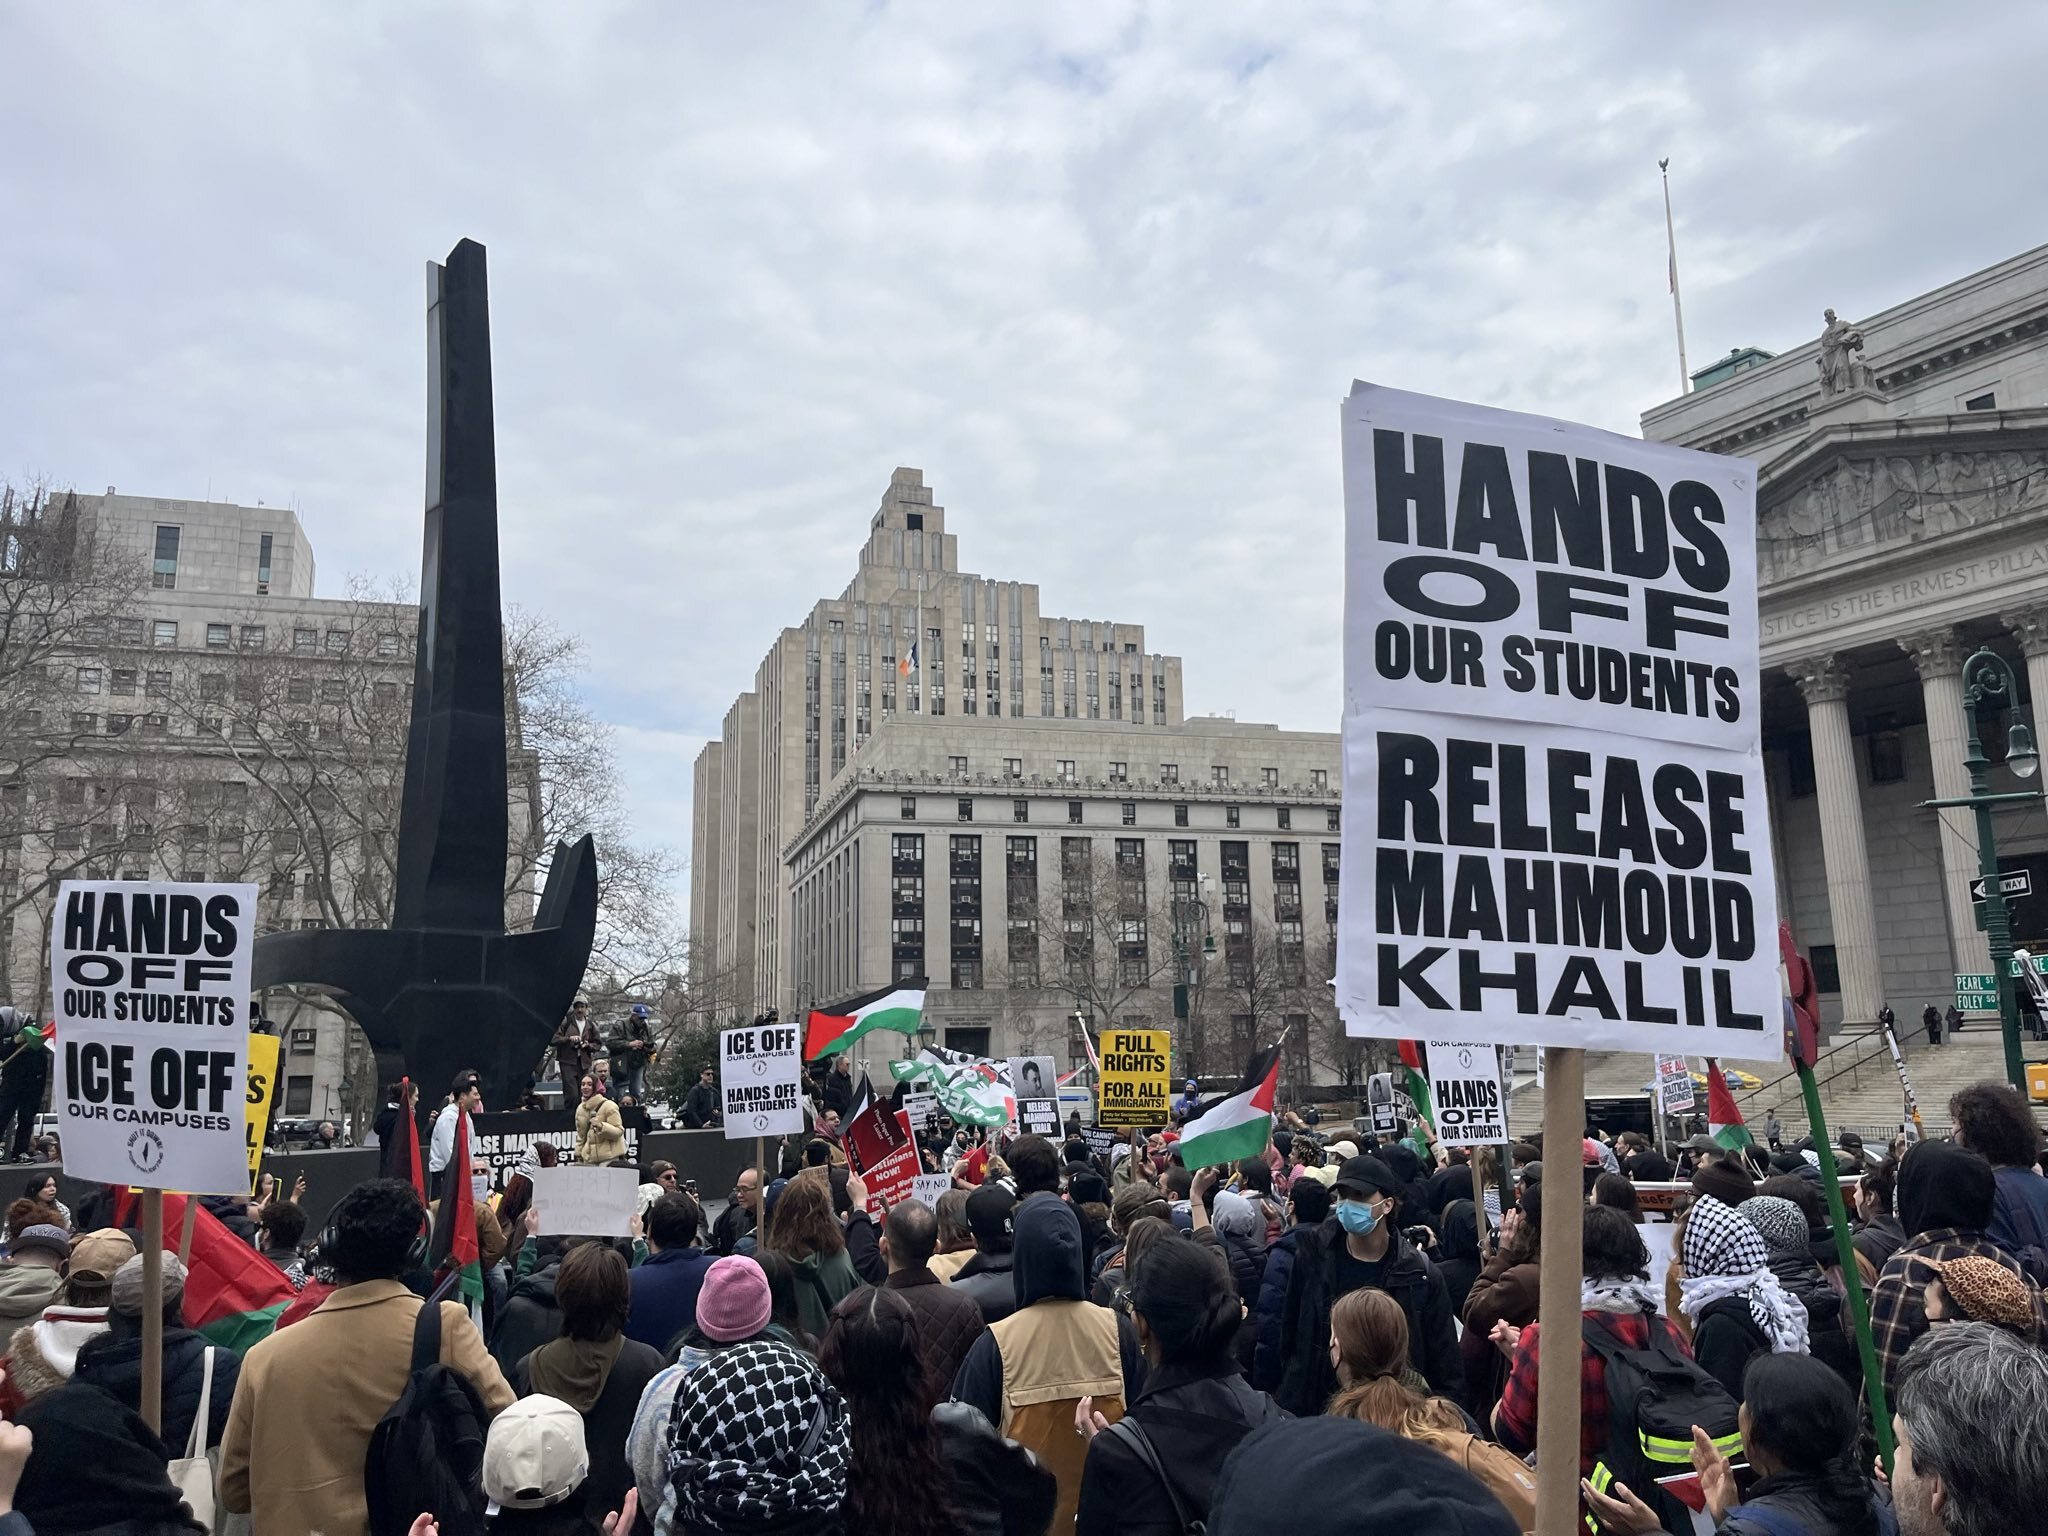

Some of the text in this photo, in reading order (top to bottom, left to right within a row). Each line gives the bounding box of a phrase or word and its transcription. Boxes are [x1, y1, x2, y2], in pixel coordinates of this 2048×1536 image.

[1373, 429, 1731, 593] HANDS
[1824, 602, 1841, 621] IS
[1846, 592, 1884, 614] THE
[1891, 565, 1981, 603] FIRMEST
[1989, 543, 2048, 578] PILLA
[1383, 555, 1729, 651] OFF
[1374, 619, 1740, 723] OUR STUDENTS
[1376, 731, 1752, 875] RELEASE
[2004, 879, 2022, 890] WAY
[1375, 847, 1755, 962] MAHMOUD
[64, 891, 240, 957] HANDS
[66, 955, 234, 992] OFF
[2011, 957, 2046, 975] CRE
[1376, 943, 1764, 1032] KHALIL
[1956, 976, 1994, 990] PEARL ST
[64, 988, 235, 1026] OUR STUDENTS
[1957, 995, 1996, 1009] FOLEY SQ
[727, 1029, 796, 1056] ICE OFF
[1115, 1035, 1155, 1053] FULL
[726, 1049, 795, 1062] OUR CAMPUSES
[1104, 1053, 1165, 1072] RIGHTS
[1675, 1060, 1686, 1071] ALL
[65, 1041, 135, 1106] ICE
[151, 1047, 236, 1113] OFF
[727, 1083, 797, 1103] HANDS OFF
[1104, 1082, 1165, 1098] FOR ALL
[1436, 1080, 1498, 1108] HANDS
[728, 1098, 797, 1114] OUR STUDENTS
[1026, 1101, 1052, 1113] RELEASE
[1103, 1098, 1164, 1108] IMMIGRANTS!
[68, 1103, 231, 1131] OUR CAMPUSES
[874, 1108, 883, 1124] Photo
[880, 1122, 890, 1137] Paper
[1023, 1112, 1057, 1124] MAHMOUD
[1440, 1109, 1499, 1124] OFF
[1092, 1131, 1114, 1140] CANNOT
[1441, 1125, 1502, 1140] OUR STUDENTS
[1086, 1138, 1110, 1147] COVERUP
[493, 1154, 521, 1166] OFF
[868, 1151, 914, 1173] estinians
[875, 1166, 901, 1182] NOW!
[916, 1179, 946, 1190] SAY NO
